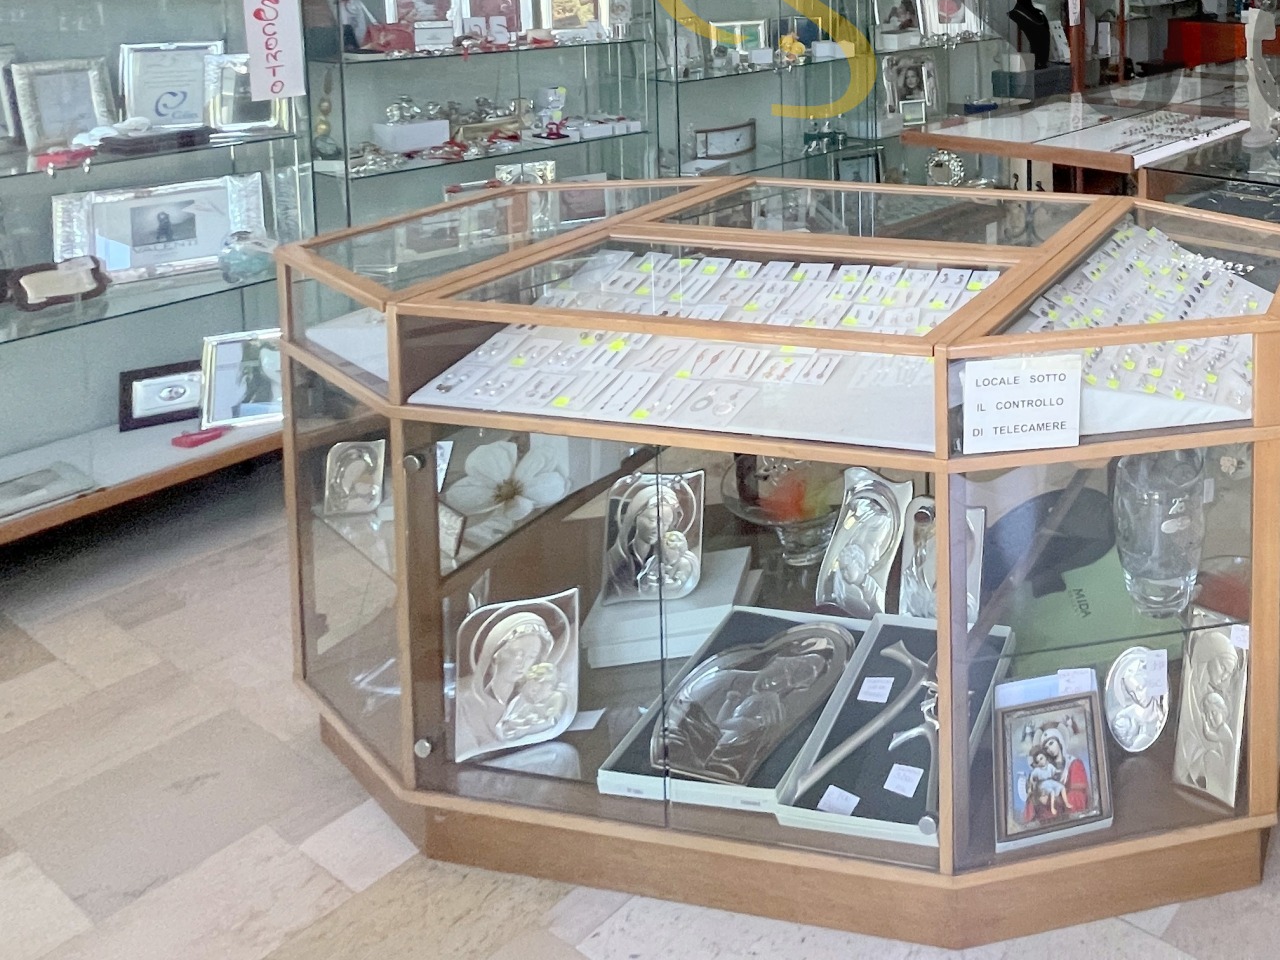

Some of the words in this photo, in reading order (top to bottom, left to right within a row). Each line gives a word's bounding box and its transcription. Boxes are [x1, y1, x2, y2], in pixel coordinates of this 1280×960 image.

[975, 376, 1020, 387] LOCALE
[1029, 373, 1067, 383] SOTTO
[976, 403, 986, 412] IL
[995, 397, 1064, 410] CONTROLLO
[972, 428, 983, 437] DI
[993, 421, 1067, 435] TELECAMERE
[1072, 588, 1092, 618] MIDA
